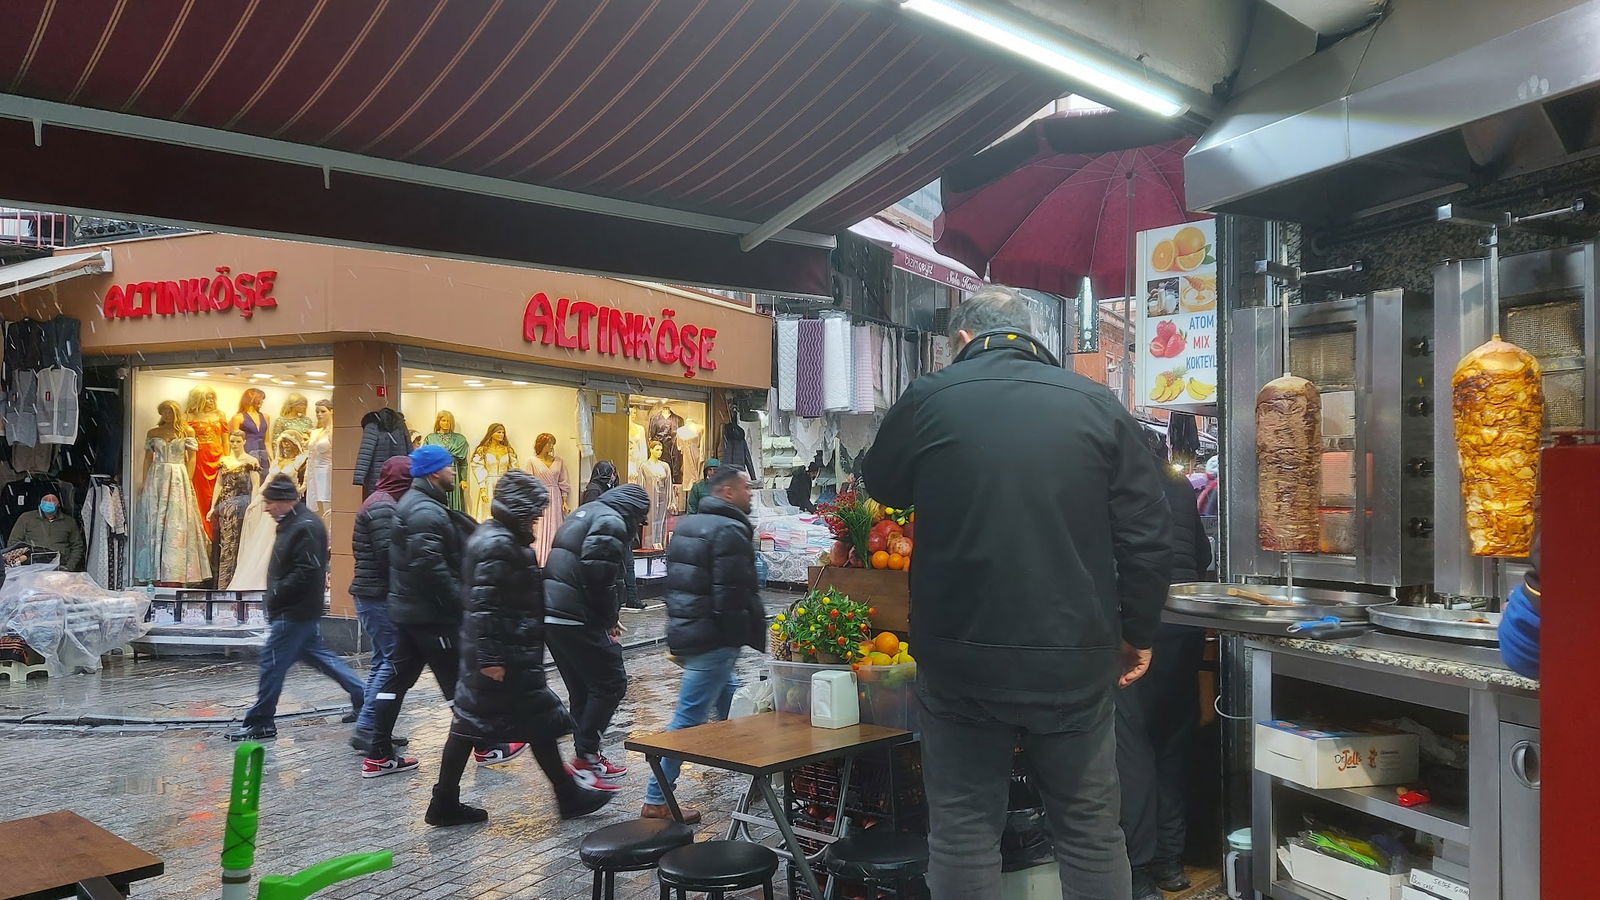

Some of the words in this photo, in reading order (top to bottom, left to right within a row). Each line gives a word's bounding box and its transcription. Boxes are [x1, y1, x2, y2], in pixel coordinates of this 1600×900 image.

[104, 266, 278, 319] ALTINKÖŞE
[1189, 315, 1214, 330] ATOM
[523, 292, 717, 378] ALTINKÖŞE
[1193, 336, 1210, 349] MIX
[1186, 355, 1217, 369] KOKTEYL
